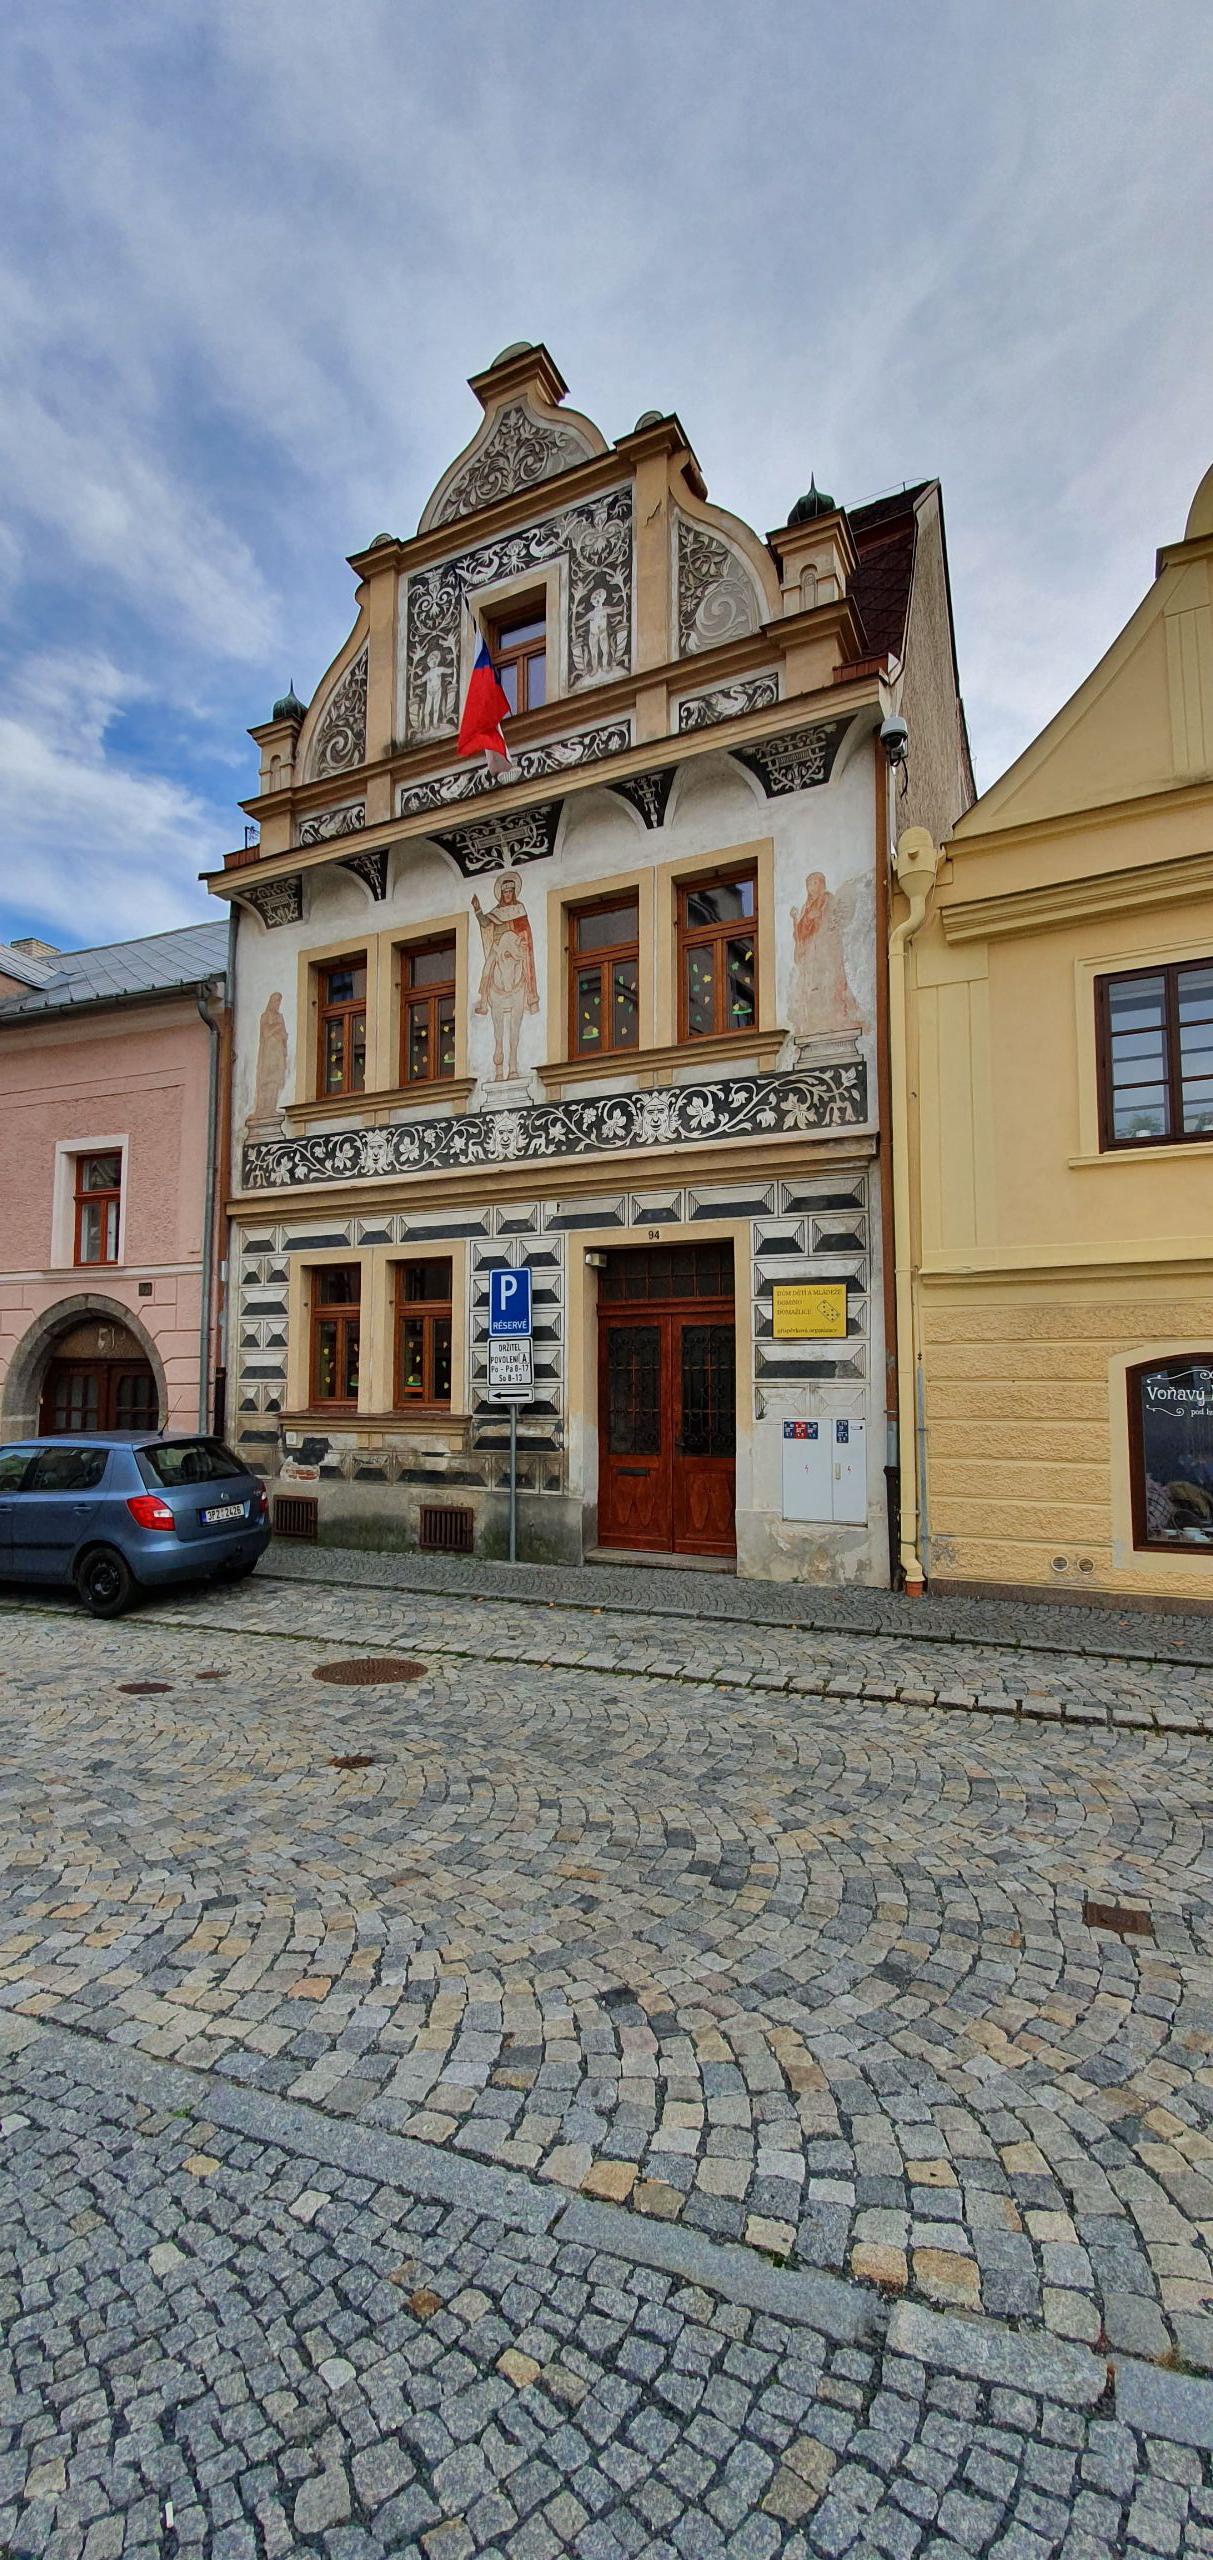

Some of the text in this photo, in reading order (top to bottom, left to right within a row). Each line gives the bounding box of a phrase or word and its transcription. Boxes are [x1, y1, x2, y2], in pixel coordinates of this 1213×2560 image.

[648, 1230, 660, 1240] 94
[501, 1274, 517, 1310] P
[493, 1319, 528, 1330] RÉSERVÉ
[498, 1343, 521, 1352] DRŽITEL
[490, 1354, 519, 1364] POVOLENÍ
[491, 1365, 499, 1373] Po
[499, 1374, 507, 1382] So
[1146, 1386, 1206, 1406] Voňavý
[1190, 1408, 1205, 1418] pod
[207, 1510, 220, 1520] 3P2
